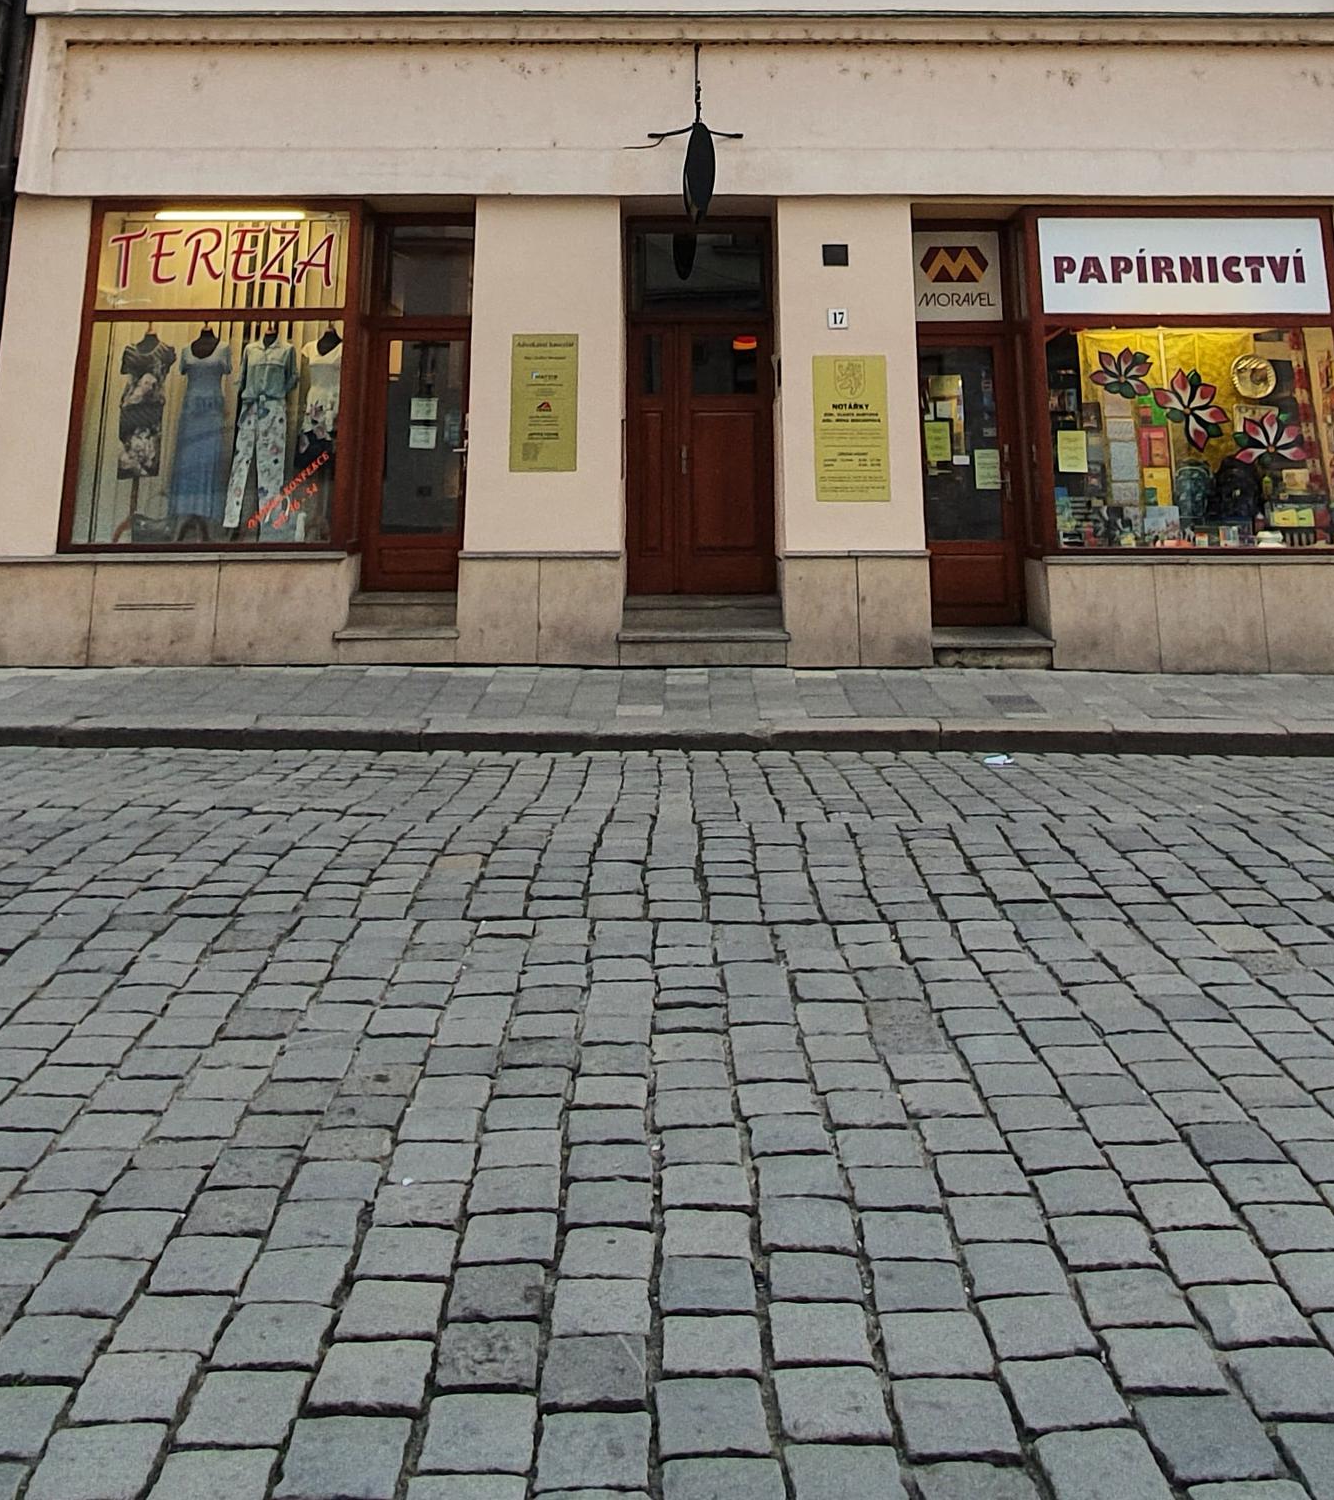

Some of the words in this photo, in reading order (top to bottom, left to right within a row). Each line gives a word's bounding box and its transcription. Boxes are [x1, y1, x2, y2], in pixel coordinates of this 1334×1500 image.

[108, 225, 337, 290] TEREZA
[1052, 247, 1307, 285] PAPÍRNICTVÍ
[832, 311, 845, 325] 17
[918, 292, 996, 307] MORAVEL
[282, 450, 331, 496] KONFEKCE
